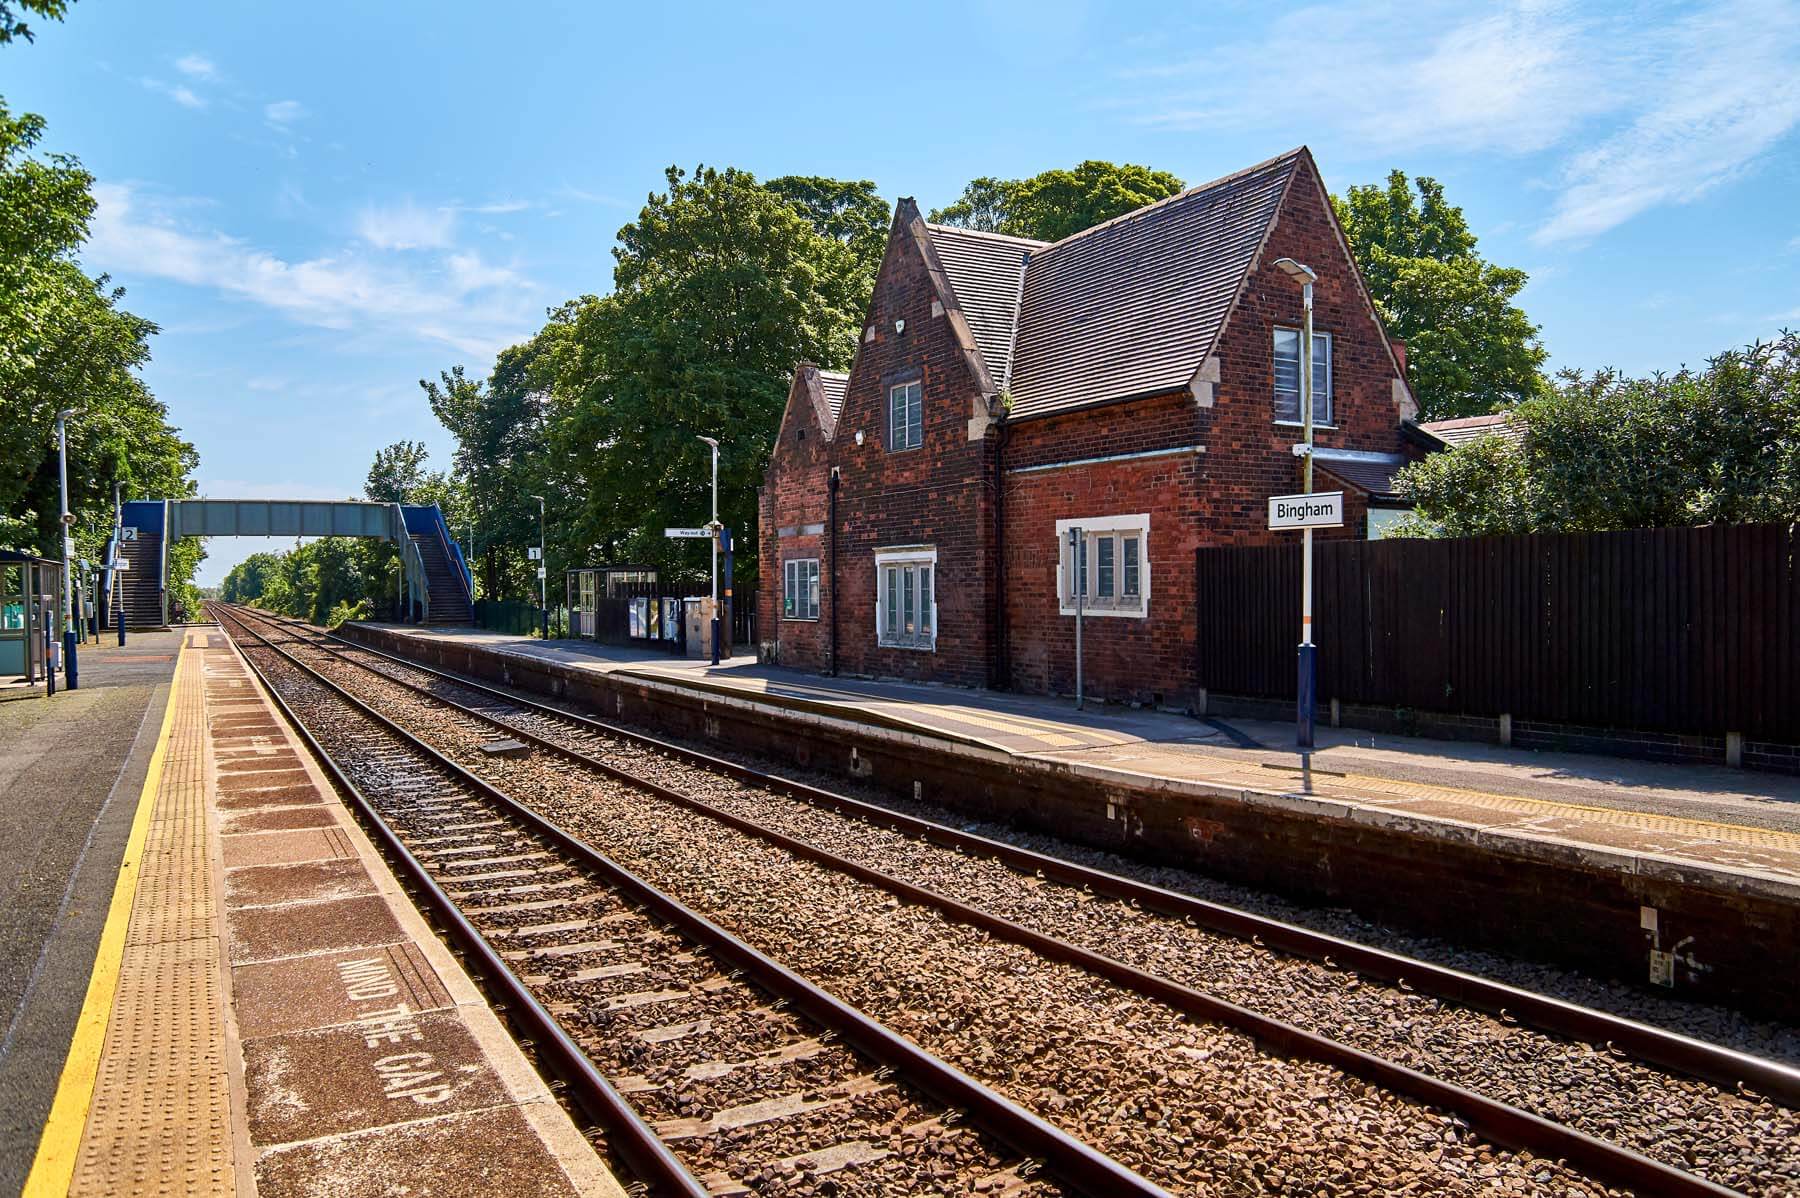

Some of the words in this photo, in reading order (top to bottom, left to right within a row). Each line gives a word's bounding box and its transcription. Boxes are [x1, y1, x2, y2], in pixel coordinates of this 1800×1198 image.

[1277, 501, 1333, 521] Bingham
[125, 529, 134, 539] 2
[532, 550, 536, 559] 1
[336, 958, 400, 1001] MIND
[355, 1003, 424, 1048] THE
[373, 1051, 453, 1105] GAP
